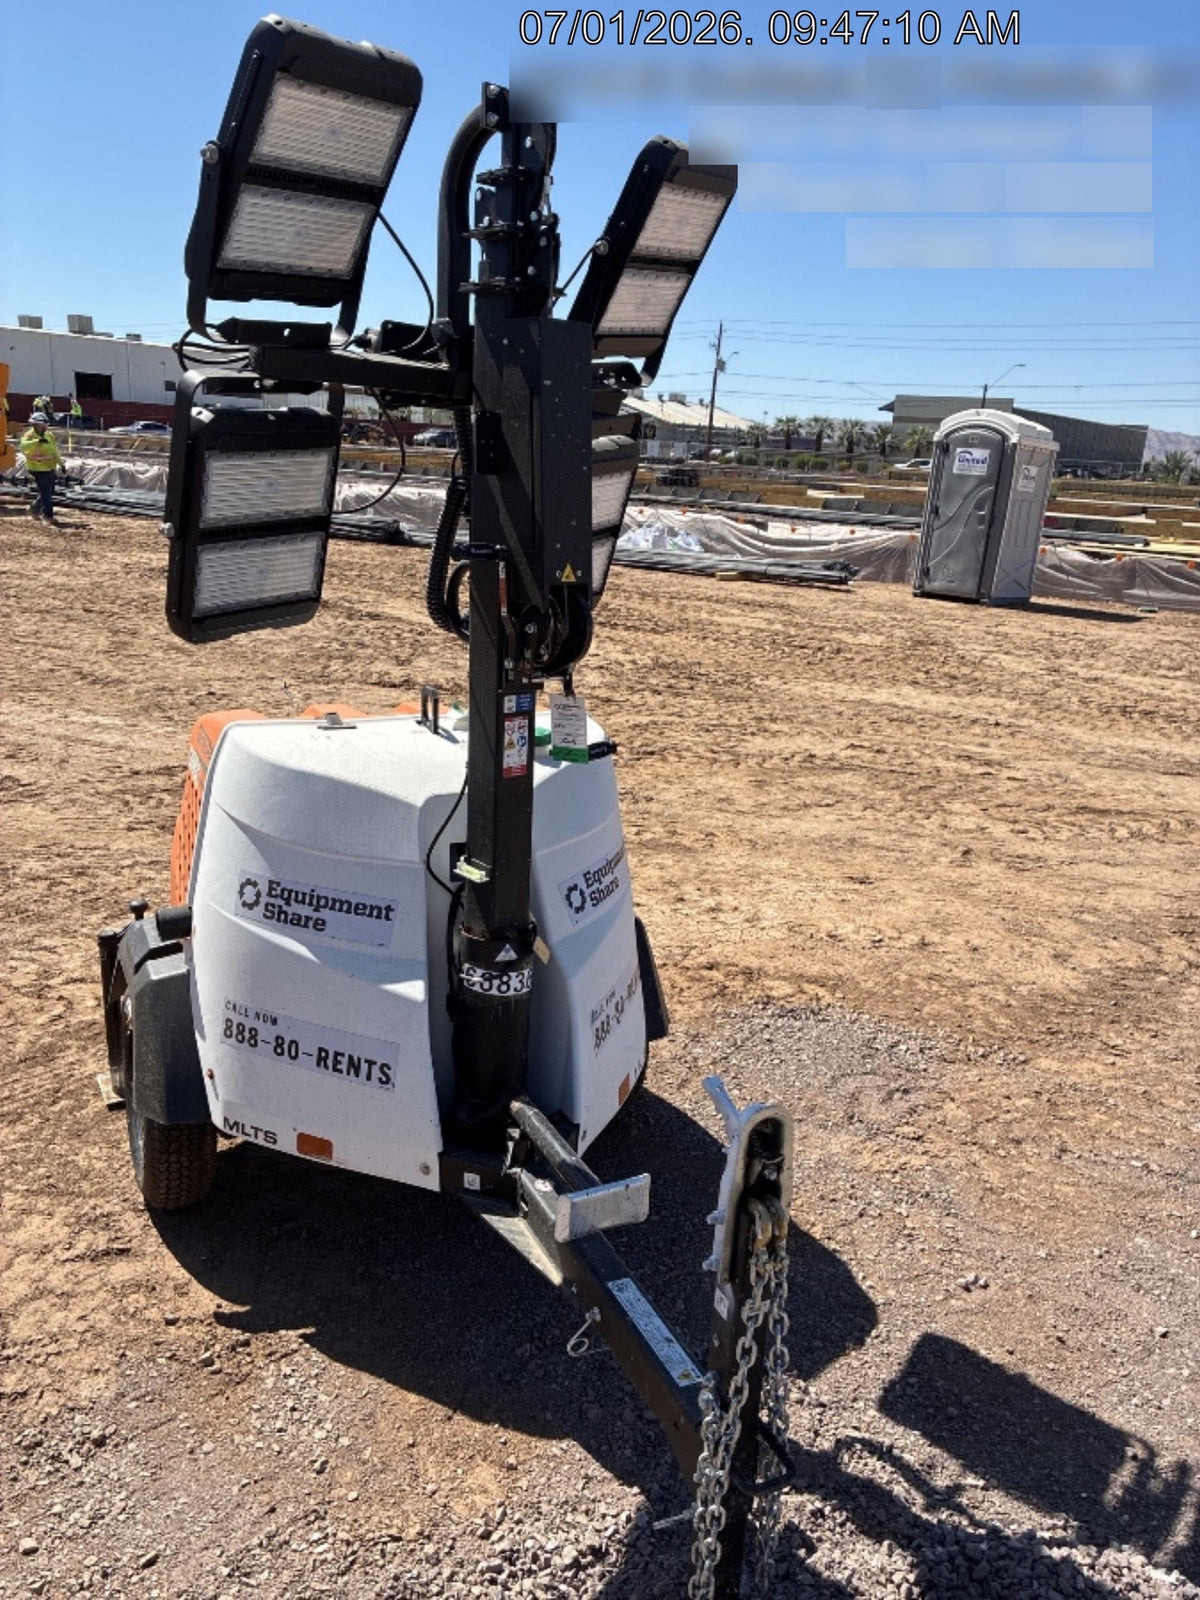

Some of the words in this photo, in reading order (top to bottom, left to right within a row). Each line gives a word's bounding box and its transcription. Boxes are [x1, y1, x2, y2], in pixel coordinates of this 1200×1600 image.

[266, 879, 395, 922] Equipment
[262, 902, 326, 932] Share
[225, 1000, 249, 1018] CALL
[254, 1011, 278, 1026] NOW
[223, 1018, 392, 1085] 888-80-RENTS
[223, 1116, 278, 1145] MLTS
